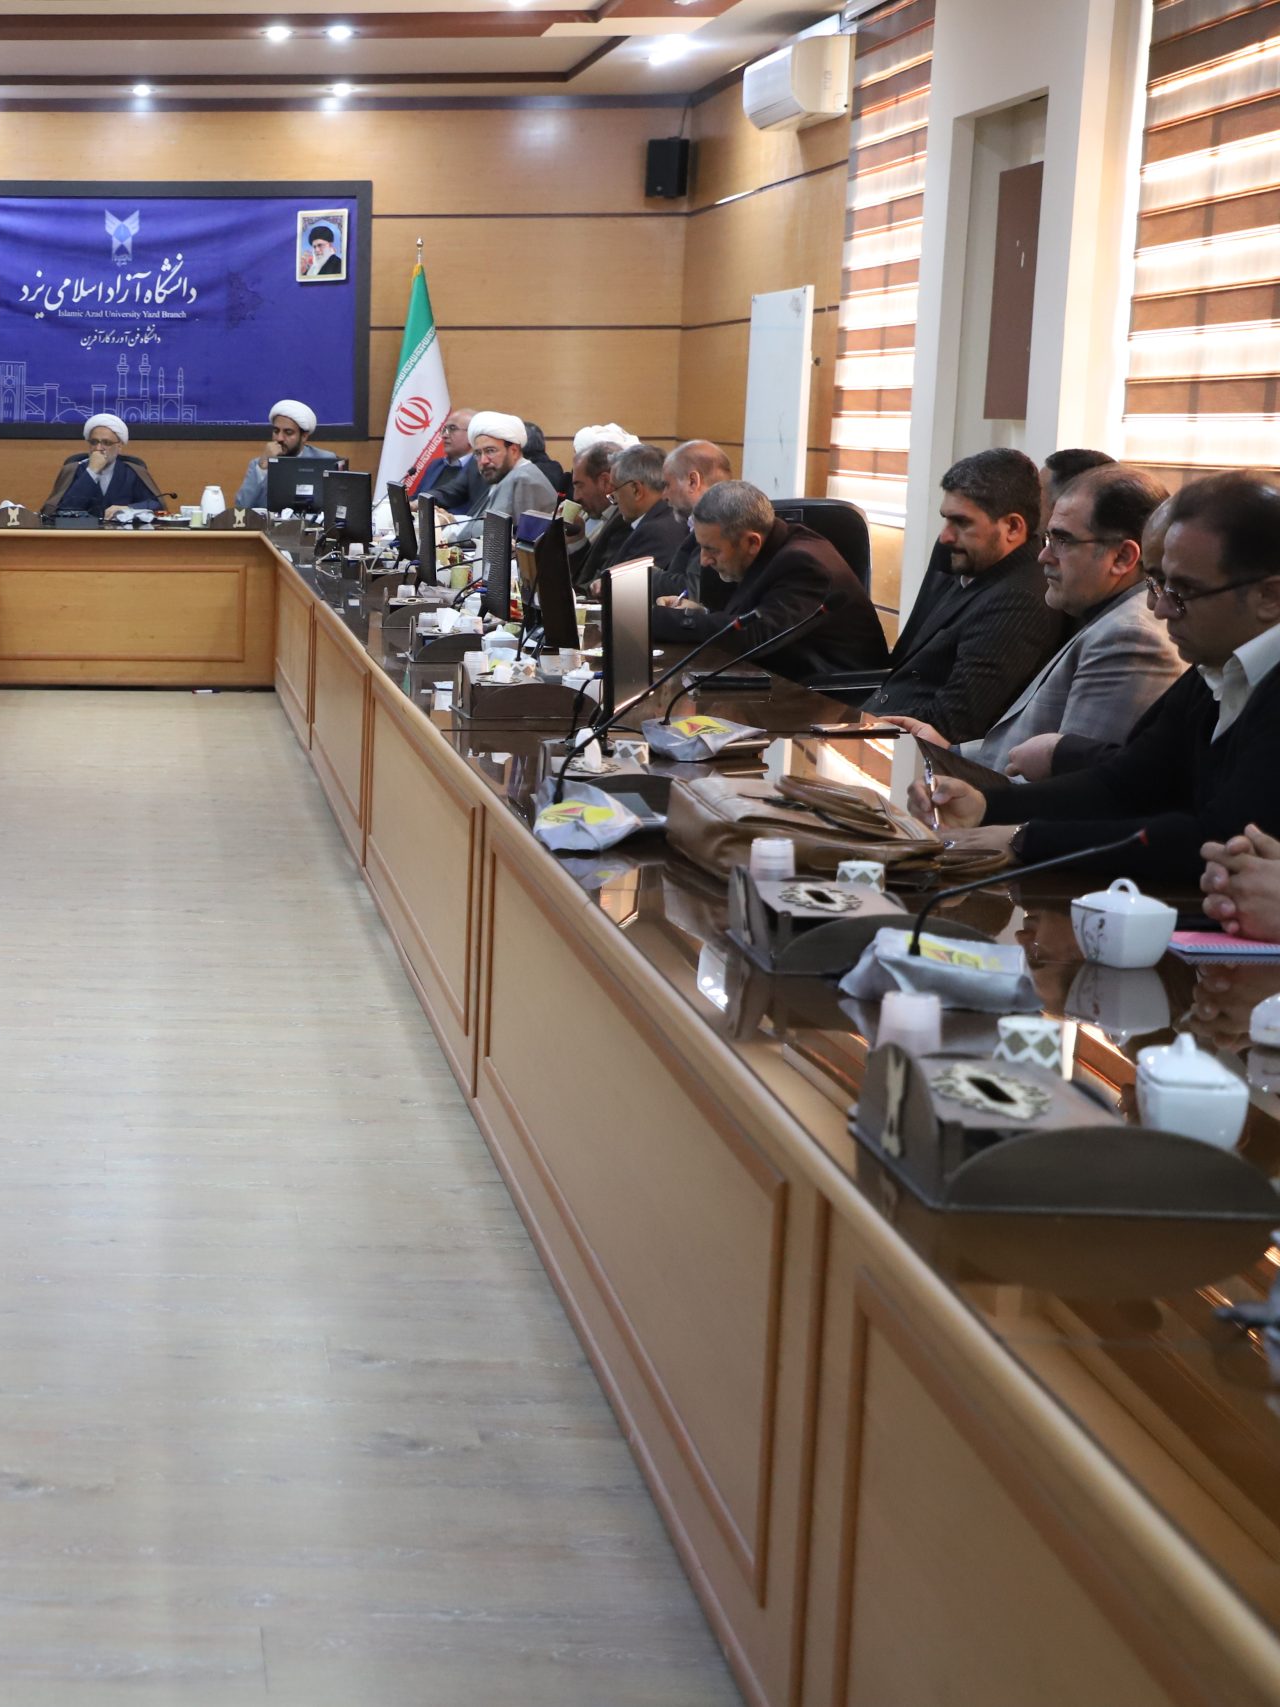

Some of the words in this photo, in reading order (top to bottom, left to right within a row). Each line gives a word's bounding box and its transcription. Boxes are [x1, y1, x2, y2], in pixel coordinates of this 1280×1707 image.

[18, 270, 45, 319] یزد
[44, 277, 103, 311] اسلامی
[104, 271, 151, 304] آزاد
[143, 253, 197, 304] دانشگاه
[58, 309, 83, 318] Islamic
[84, 310, 104, 318] Azad
[104, 310, 141, 320] University
[142, 310, 161, 319] Yazd
[161, 310, 187, 319] Branch
